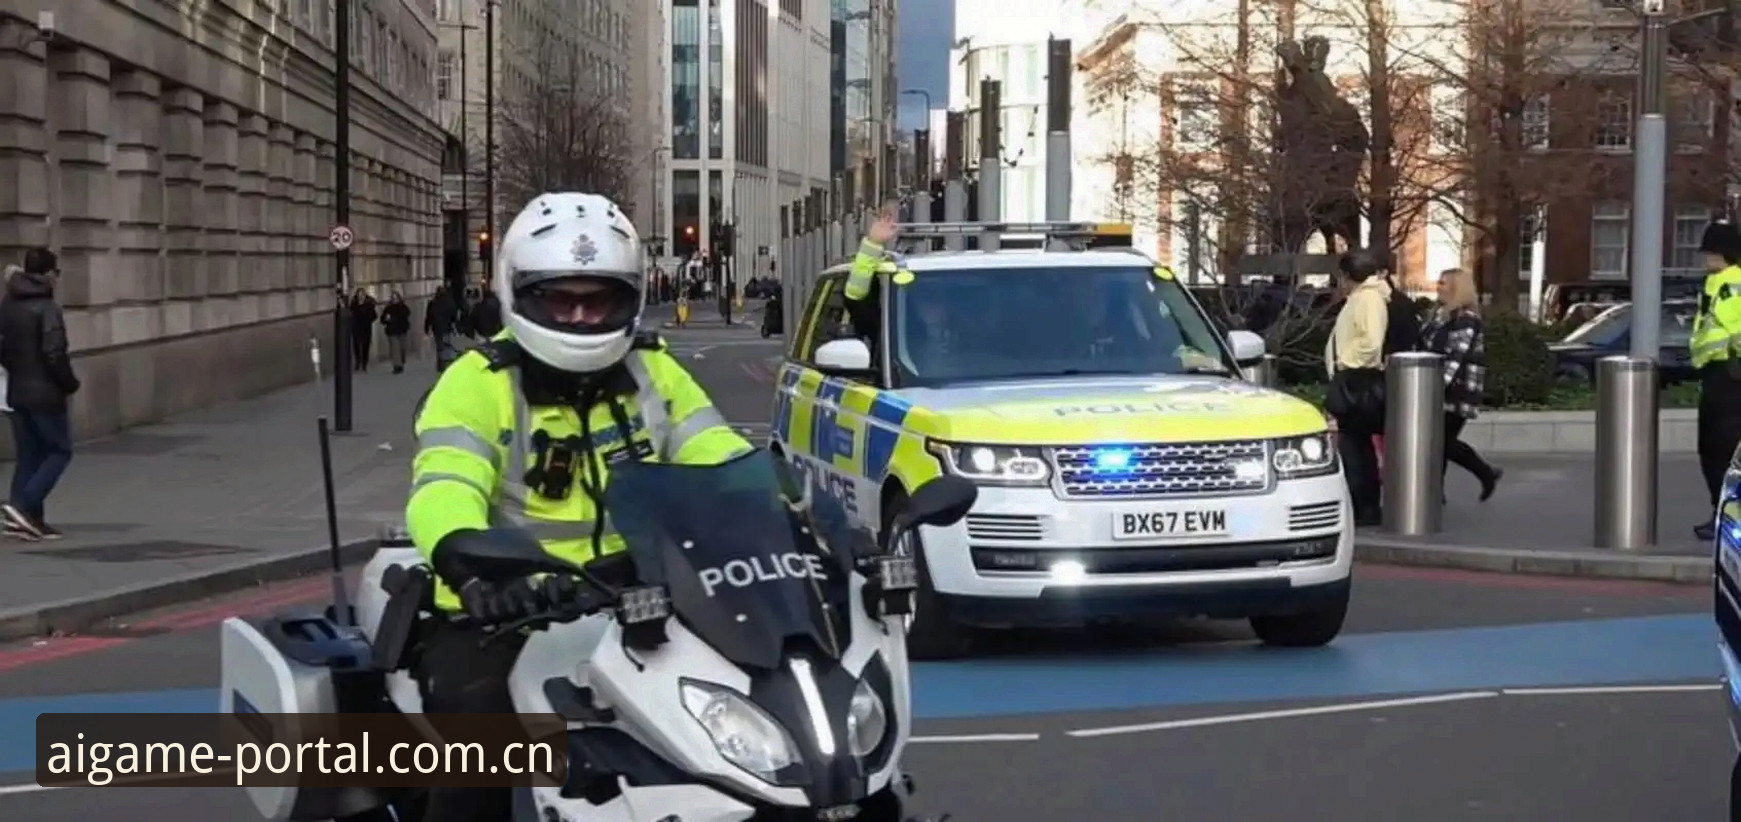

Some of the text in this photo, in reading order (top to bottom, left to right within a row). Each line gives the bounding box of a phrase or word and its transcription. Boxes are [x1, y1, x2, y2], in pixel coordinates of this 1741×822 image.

[333, 231, 352, 243] 20
[1054, 402, 1234, 417] POLICE
[1122, 509, 1226, 535] BX67 EVM
[698, 552, 829, 598] POLICE
